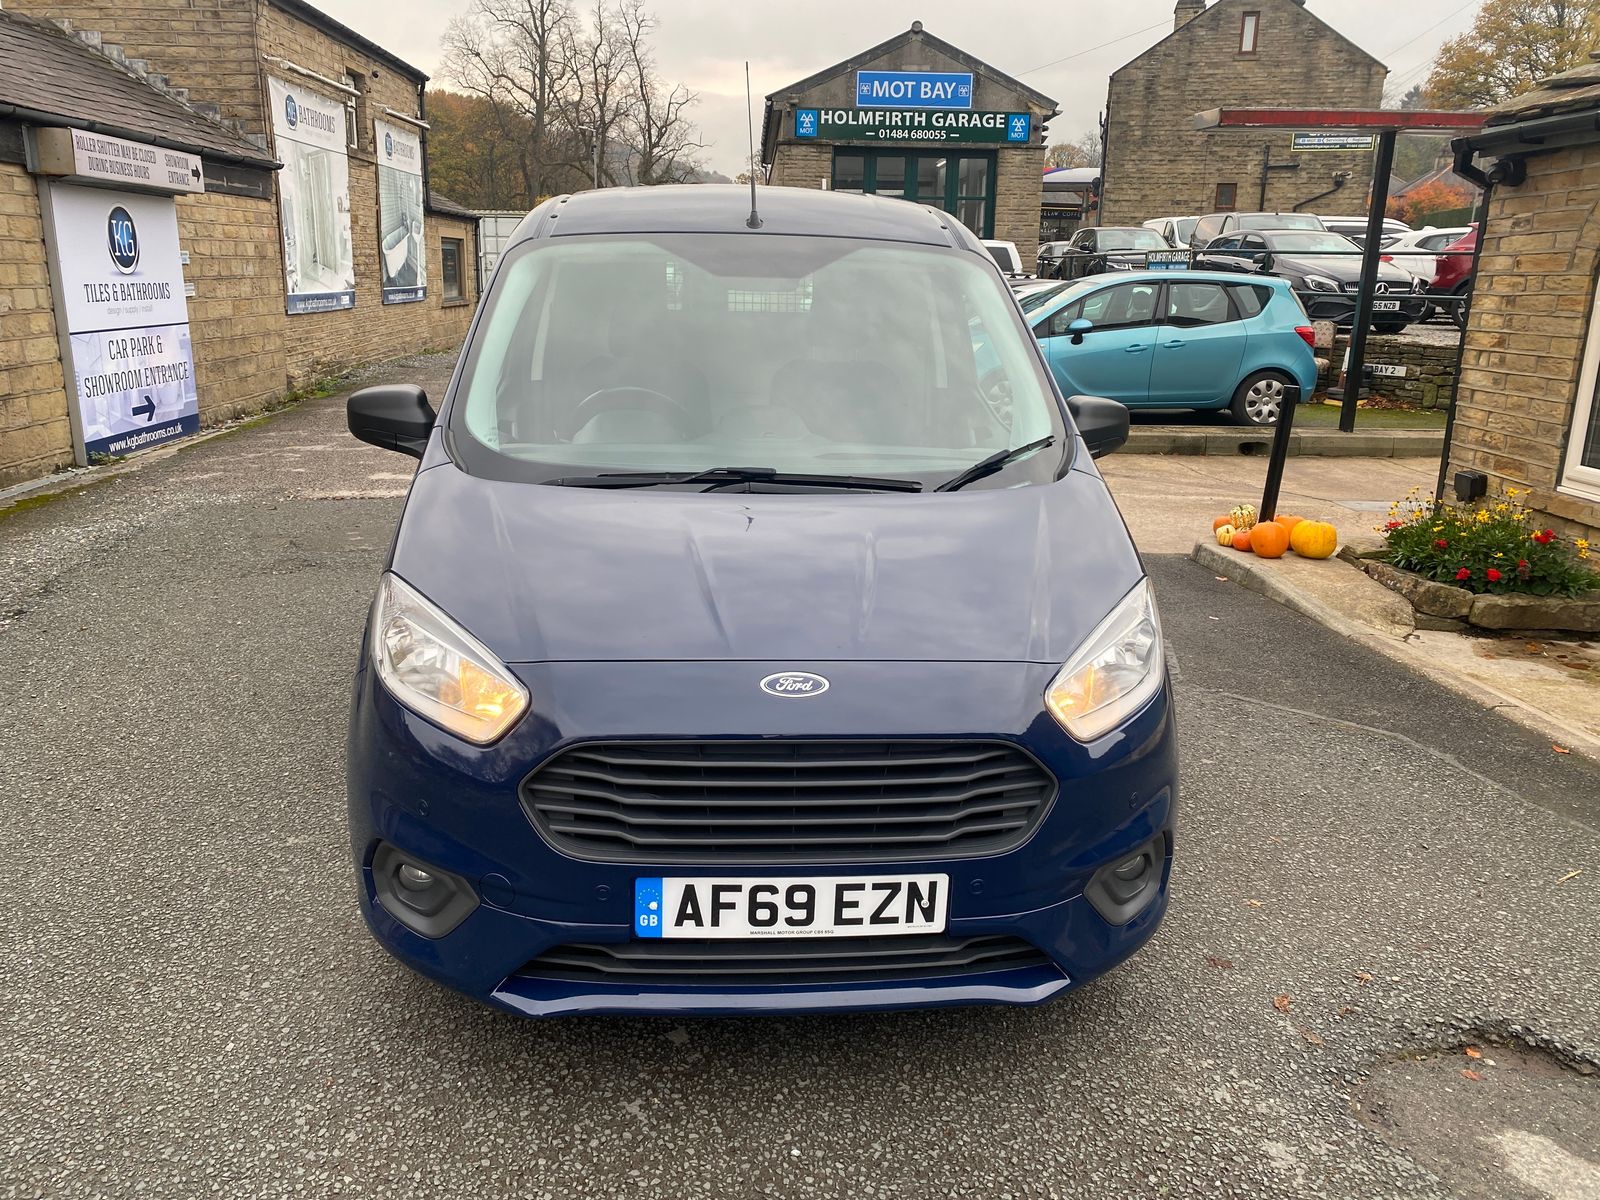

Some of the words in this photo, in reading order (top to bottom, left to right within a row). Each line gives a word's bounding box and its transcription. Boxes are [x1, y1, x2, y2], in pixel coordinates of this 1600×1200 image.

[873, 80, 916, 98] MOT
[920, 81, 956, 99] BAY
[298, 105, 336, 134] BATHROOMS
[820, 110, 926, 127] HOLMFIRTH
[931, 112, 1005, 128] GARAGE
[878, 129, 909, 139] 01484
[910, 129, 947, 139] 680055
[75, 135, 97, 152] ROLLER
[97, 140, 120, 157] SHUTTER
[120, 144, 131, 160] MAY
[131, 147, 139, 161] BE
[139, 148, 157, 164] CLOSED
[88, 156, 109, 172] DURING
[109, 160, 133, 177] BUSINESS
[134, 164, 150, 180] HOURS
[164, 153, 190, 170] SHOWROOM
[167, 171, 190, 186] ENTRANCE
[111, 220, 135, 257] KG
[1171, 251, 1190, 262] GARAGE
[83, 283, 111, 303] TILES
[112, 283, 119, 302] &
[120, 282, 171, 301] BATHROOMS
[1383, 302, 1397, 310] NZB
[108, 338, 129, 360] CAR
[130, 335, 156, 358] PARK
[156, 335, 163, 354] &
[84, 369, 143, 398] SHOWROOM
[144, 361, 190, 387] ENTRANCE
[1374, 365, 1390, 374] BAY
[1390, 366, 1397, 375] 2
[109, 422, 183, 453] www.kgbathrooms.co.uk
[775, 677, 814, 691] Ford
[674, 883, 816, 928] AF69
[833, 880, 939, 926] EZN
[639, 914, 659, 927] GB
